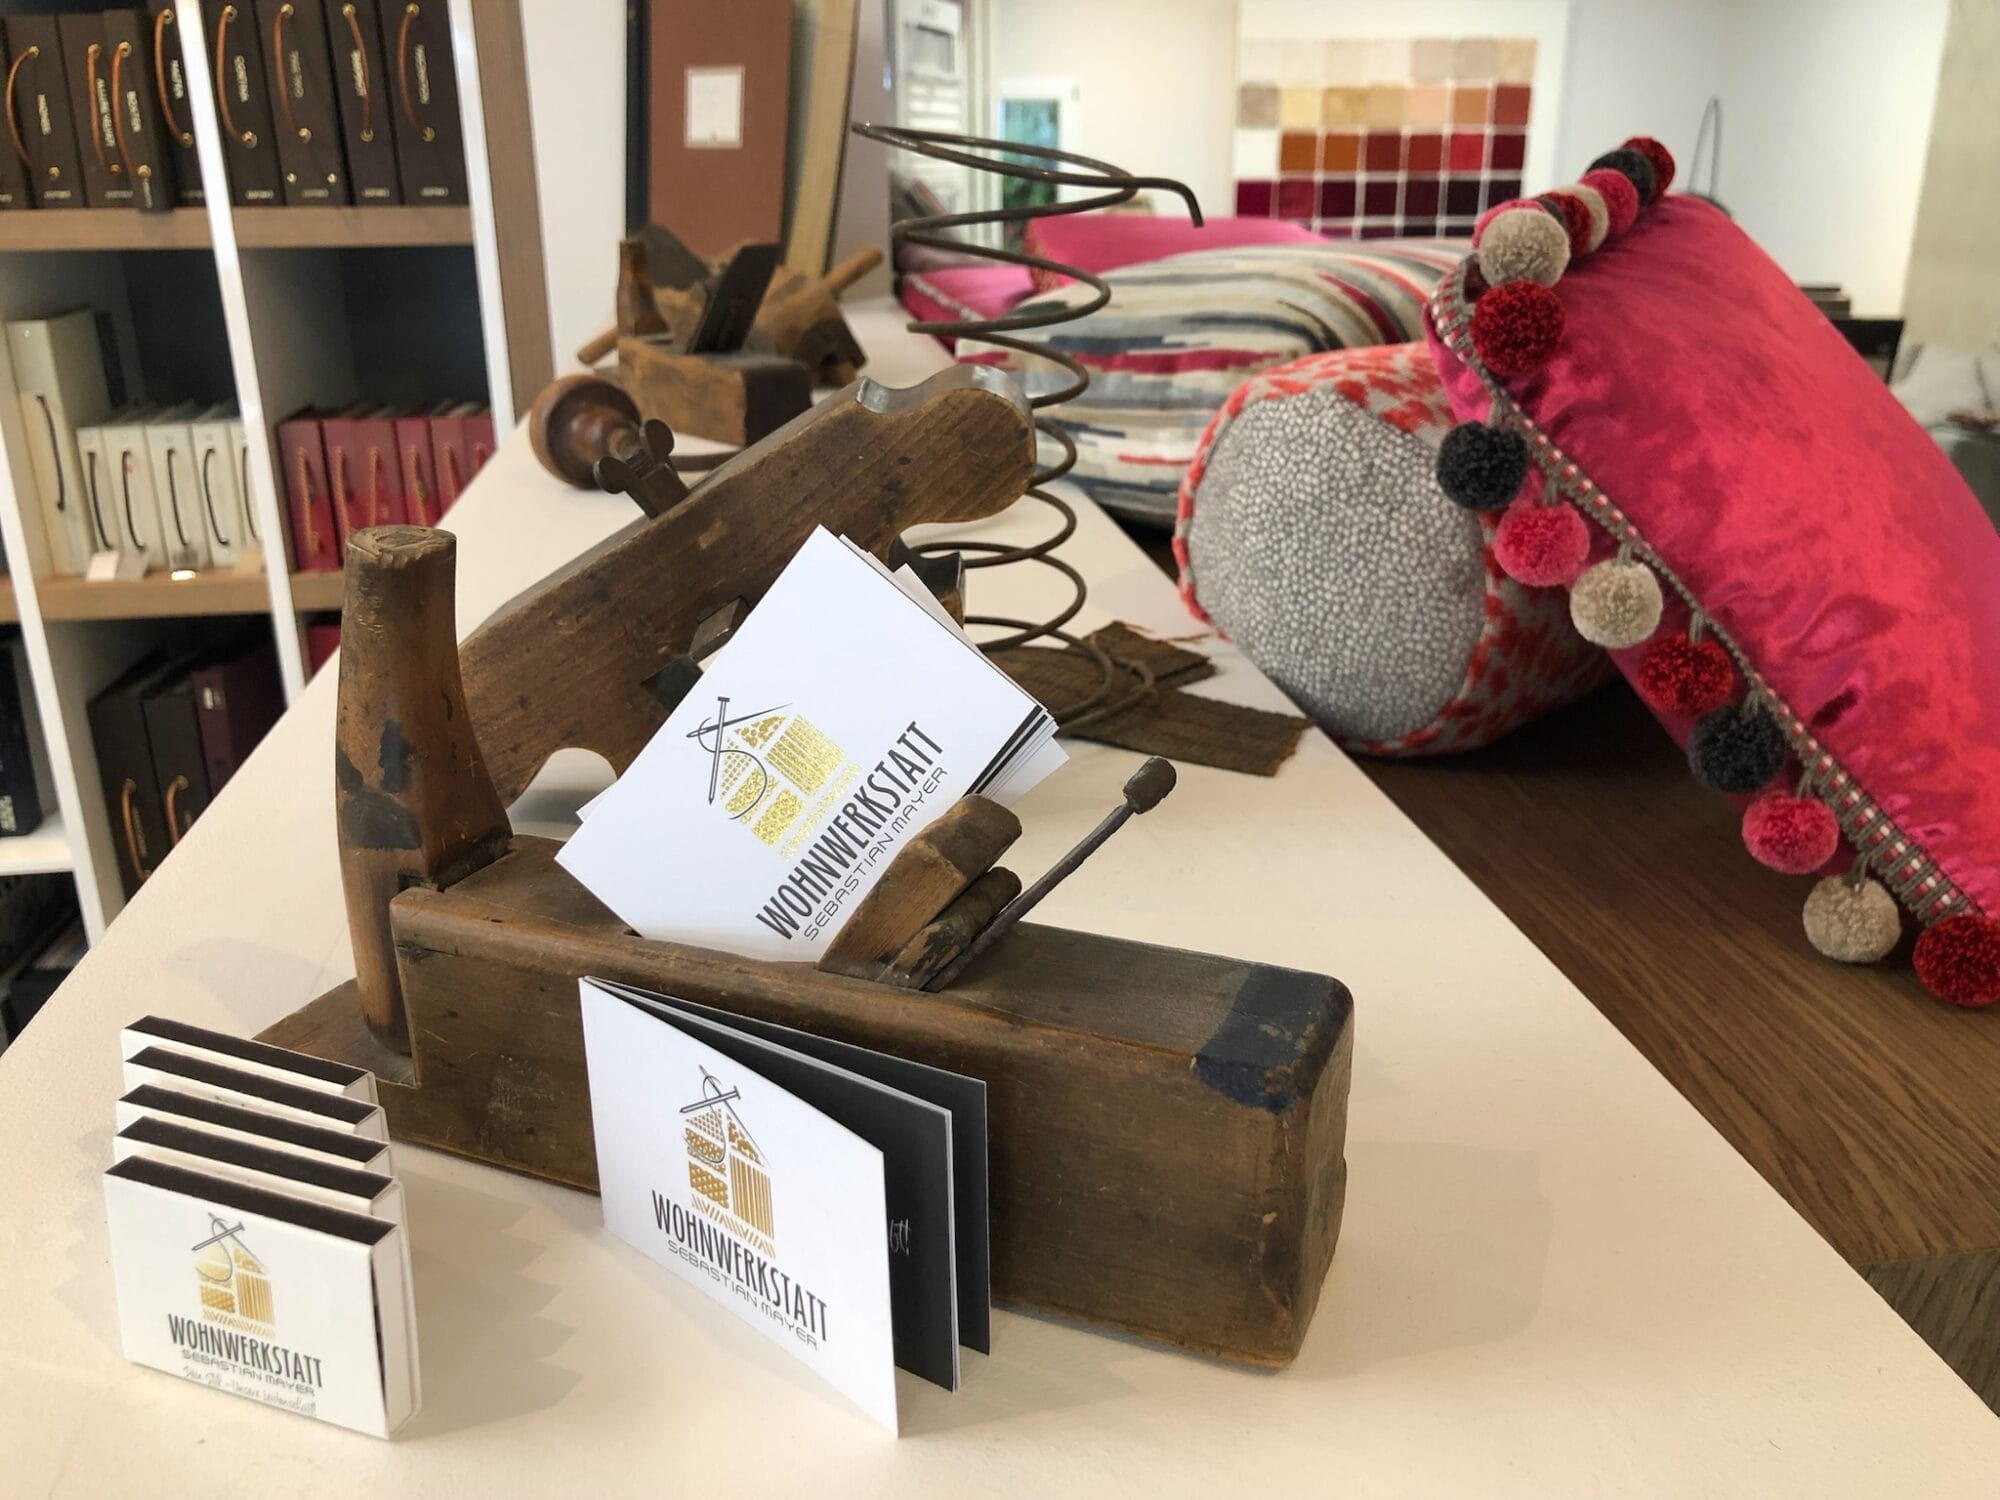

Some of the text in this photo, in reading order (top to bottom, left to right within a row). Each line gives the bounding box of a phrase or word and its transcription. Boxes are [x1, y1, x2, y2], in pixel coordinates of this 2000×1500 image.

[756, 721, 943, 940] WOHNWERKSTATT
[804, 767, 947, 941] SEBASTIAN MAYER
[652, 1189, 827, 1342] WOHNWERKSTATT
[667, 1239, 818, 1351] SEBASTIAN MAYER
[168, 1312, 323, 1388] WOHNWERKSTATT
[181, 1348, 316, 1397] SEBASTIAN MAYER
